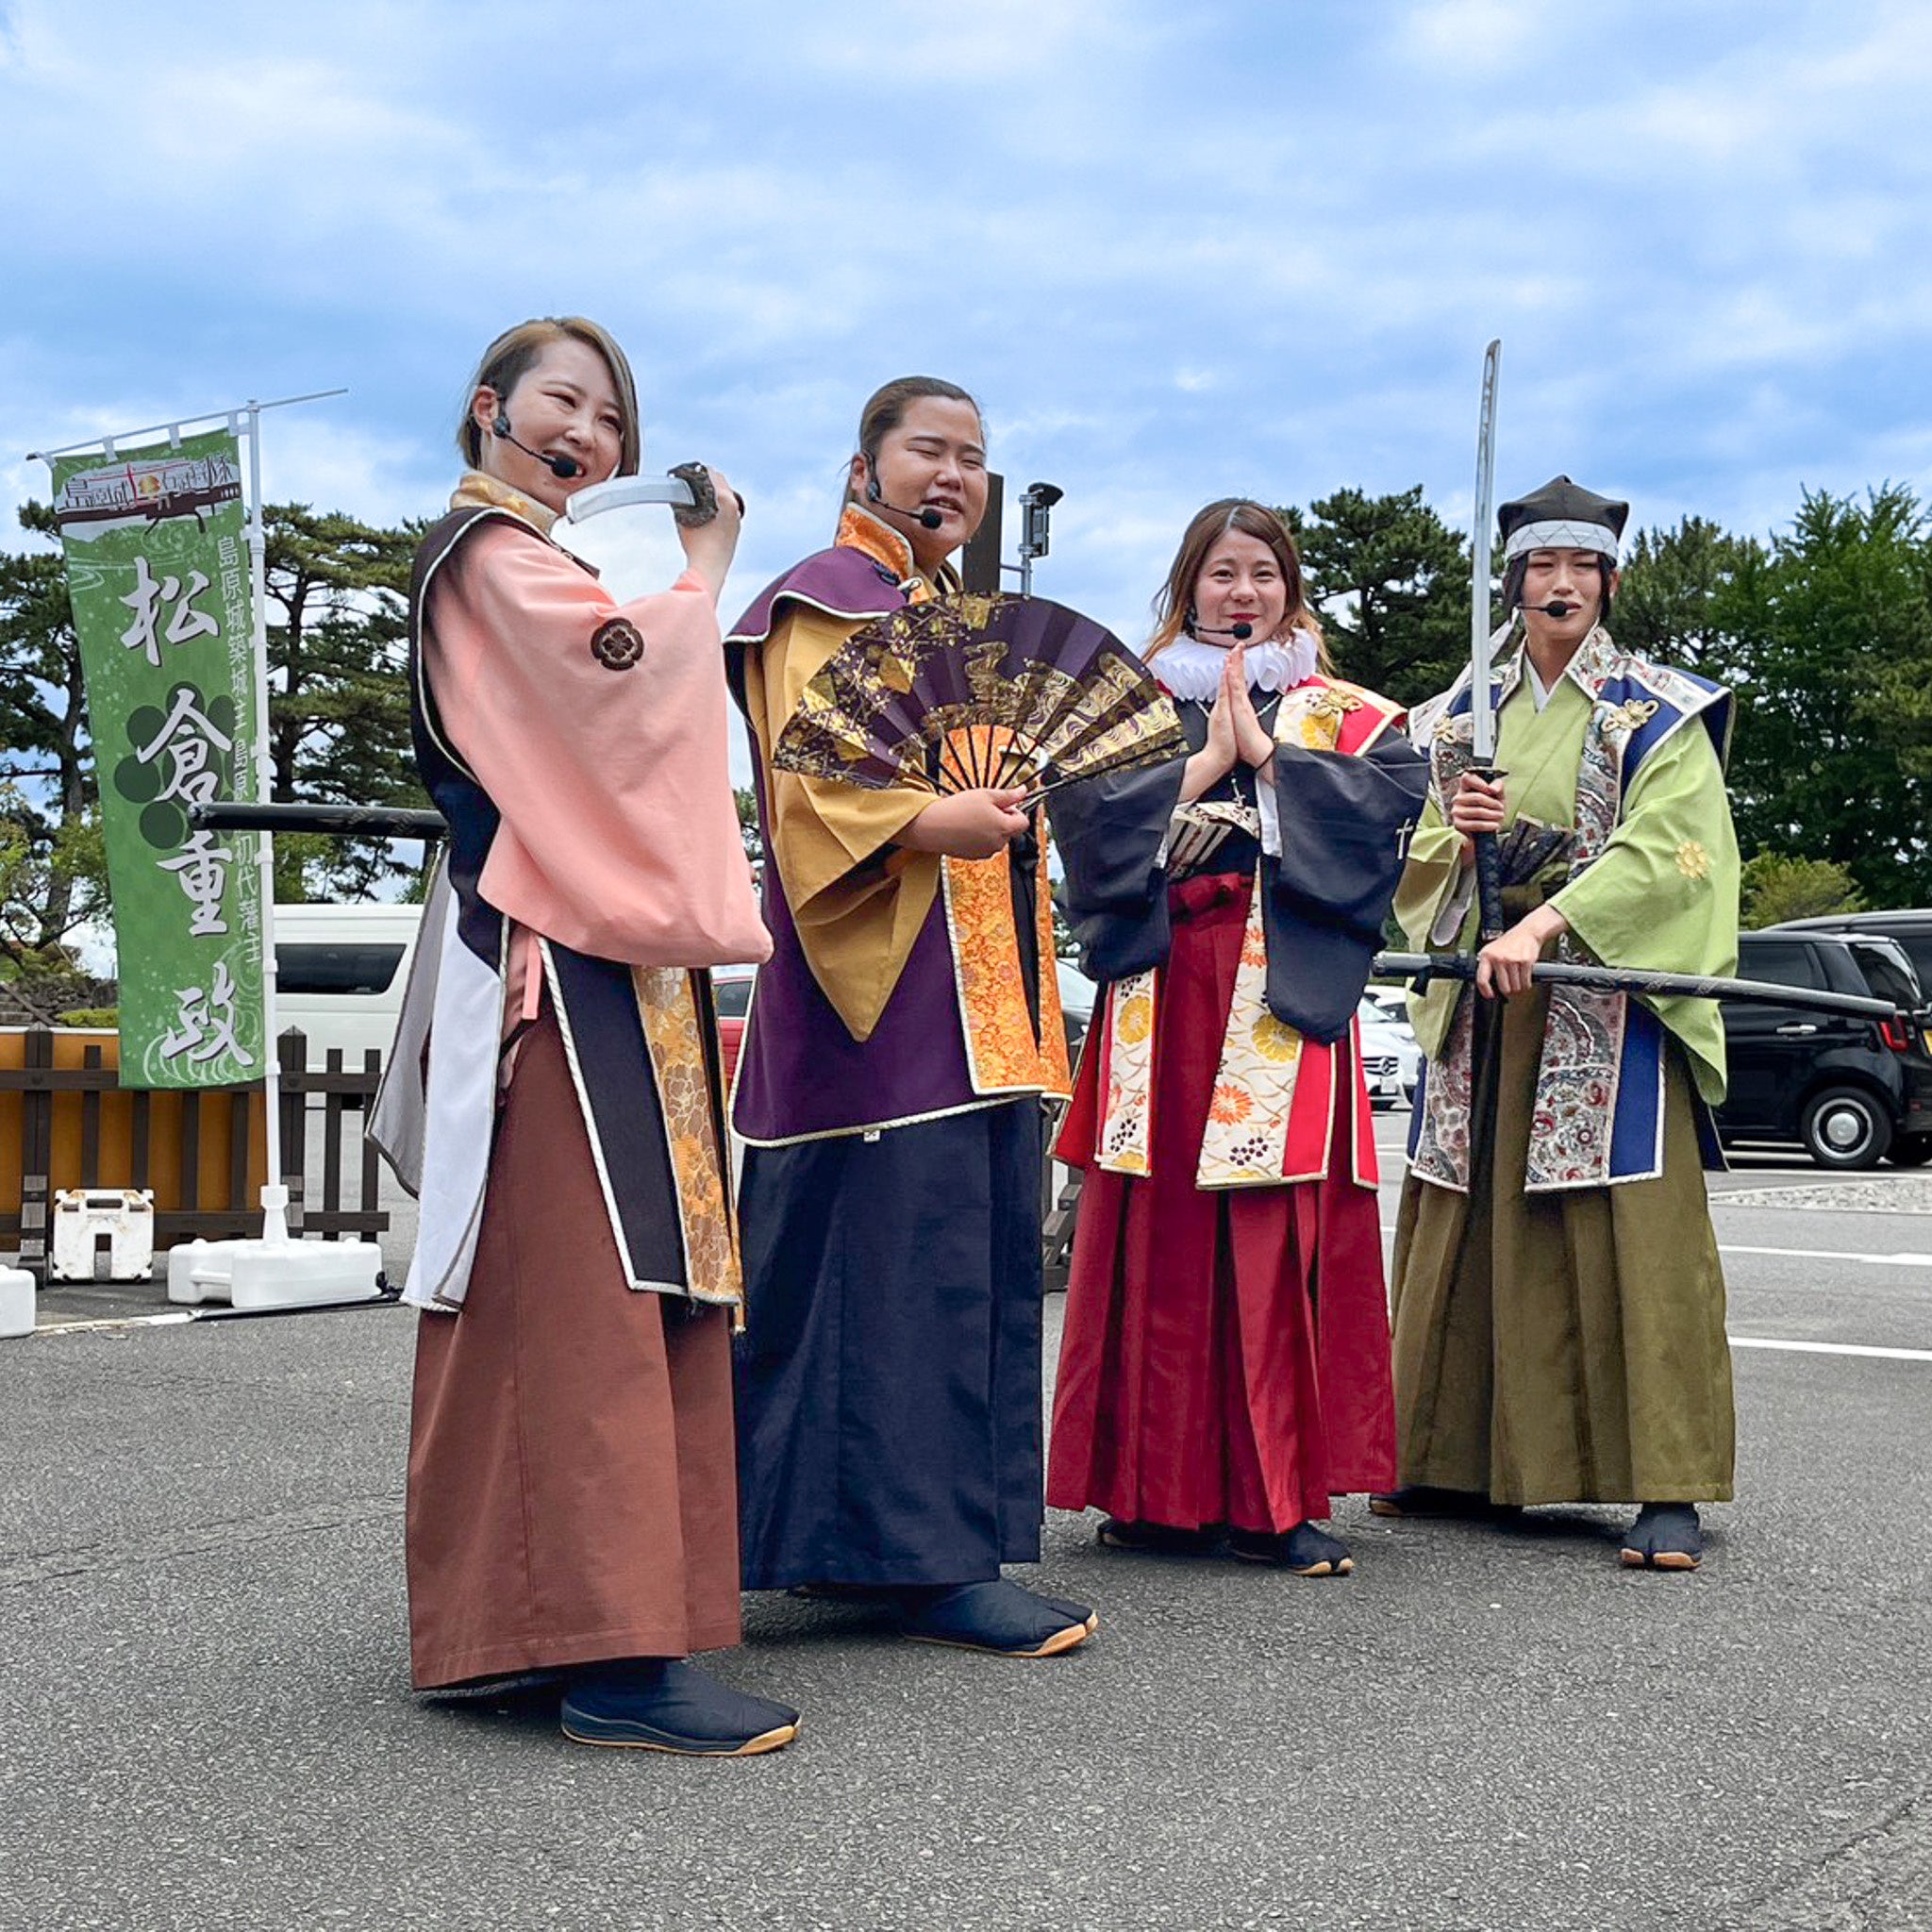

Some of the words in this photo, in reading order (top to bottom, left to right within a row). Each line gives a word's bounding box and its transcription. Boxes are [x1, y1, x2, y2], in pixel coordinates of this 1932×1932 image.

[119, 556, 254, 1066] 松倉重政
[235, 739, 262, 963] 島原初代藩主
